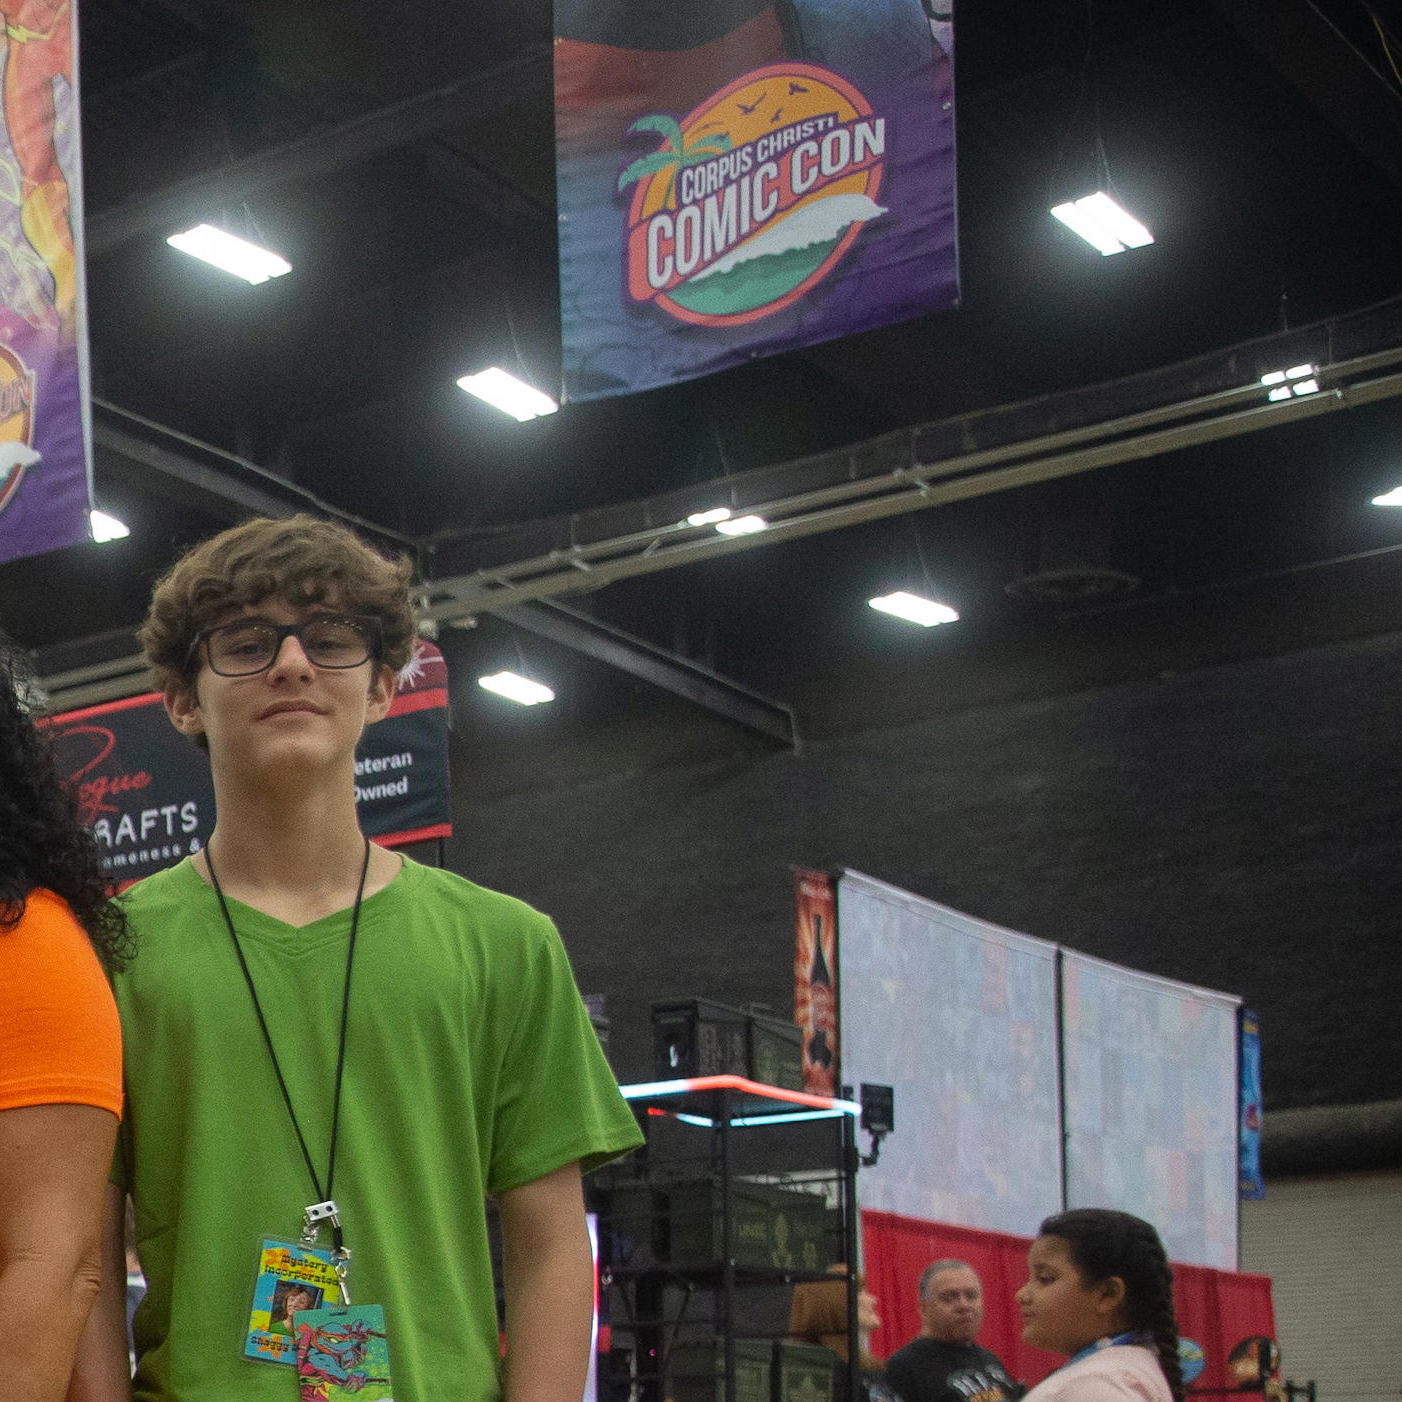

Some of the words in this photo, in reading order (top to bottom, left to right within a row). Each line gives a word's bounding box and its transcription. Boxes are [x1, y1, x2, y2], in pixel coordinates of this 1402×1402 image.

[682, 146, 752, 204] CORPUS
[757, 117, 834, 162] CHRISTI
[647, 161, 777, 288] COMIC
[791, 118, 885, 195] CON
[355, 752, 413, 776] eteran
[95, 801, 199, 848] RAFTS
